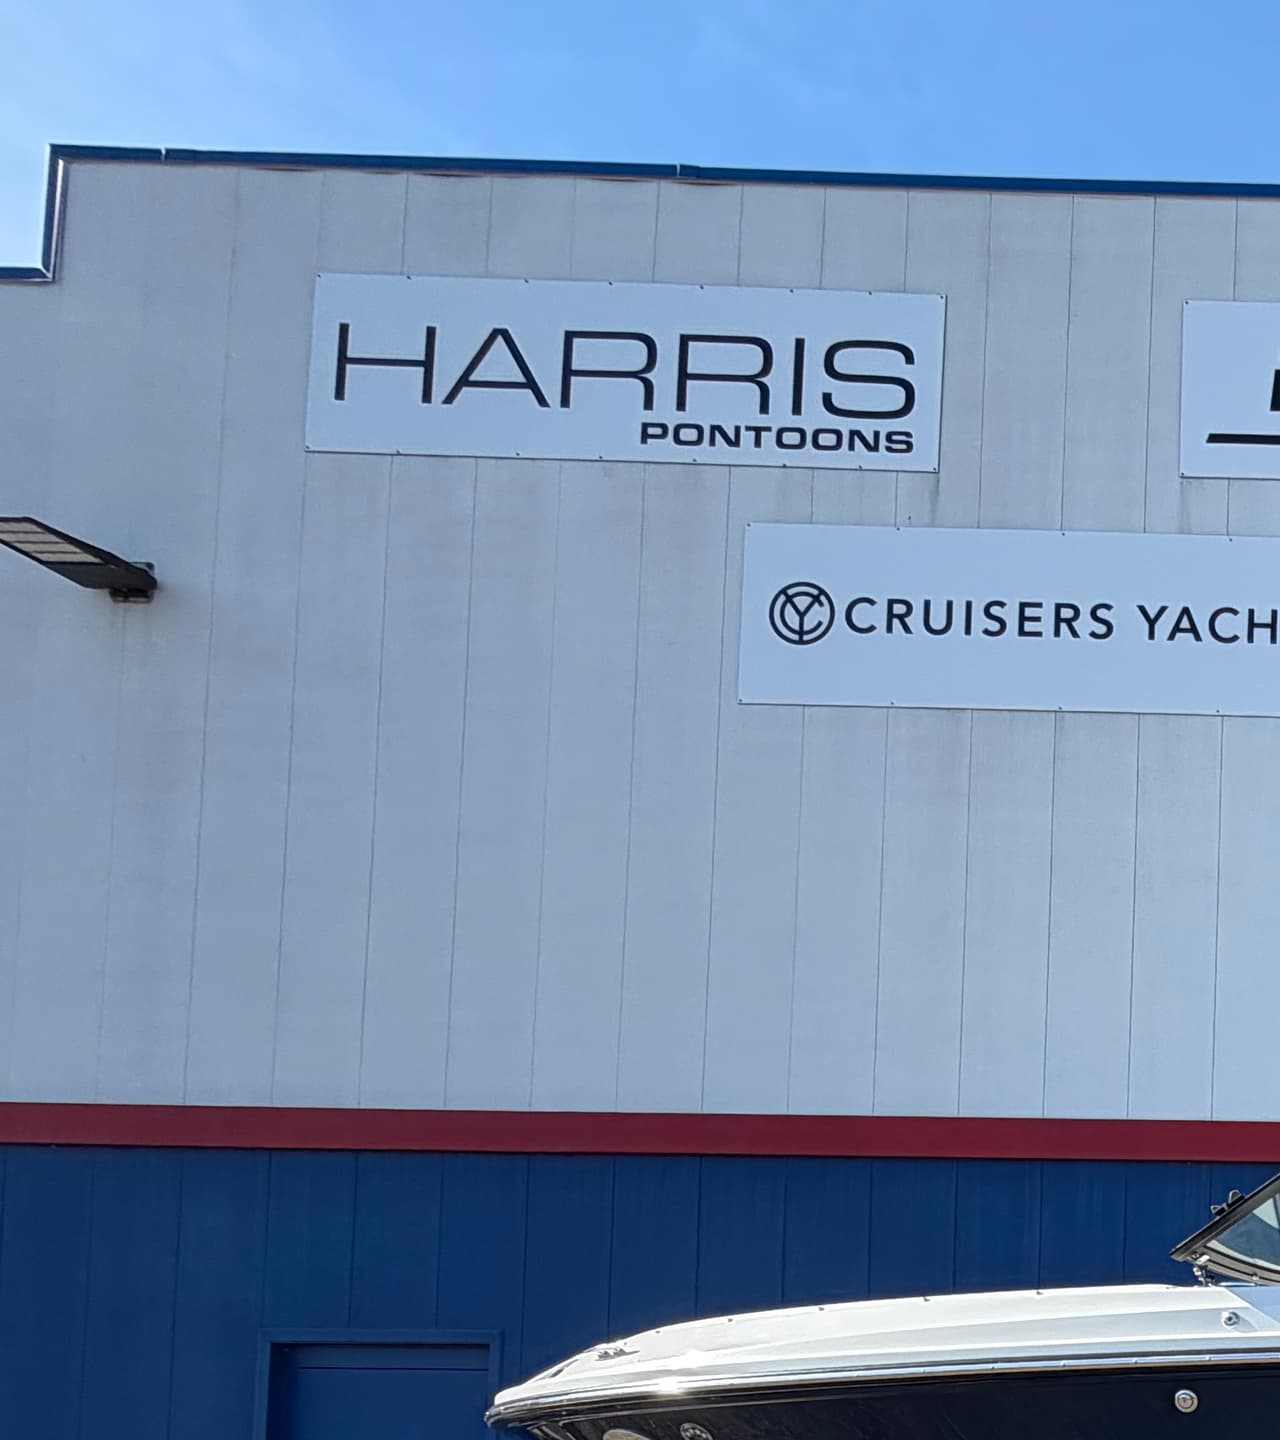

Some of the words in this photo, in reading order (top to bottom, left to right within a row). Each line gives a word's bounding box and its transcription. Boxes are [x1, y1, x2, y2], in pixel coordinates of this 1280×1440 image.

[334, 321, 916, 420] HARRIS
[640, 420, 914, 454] PONTOONS
[844, 596, 1114, 640] CRUISERS
